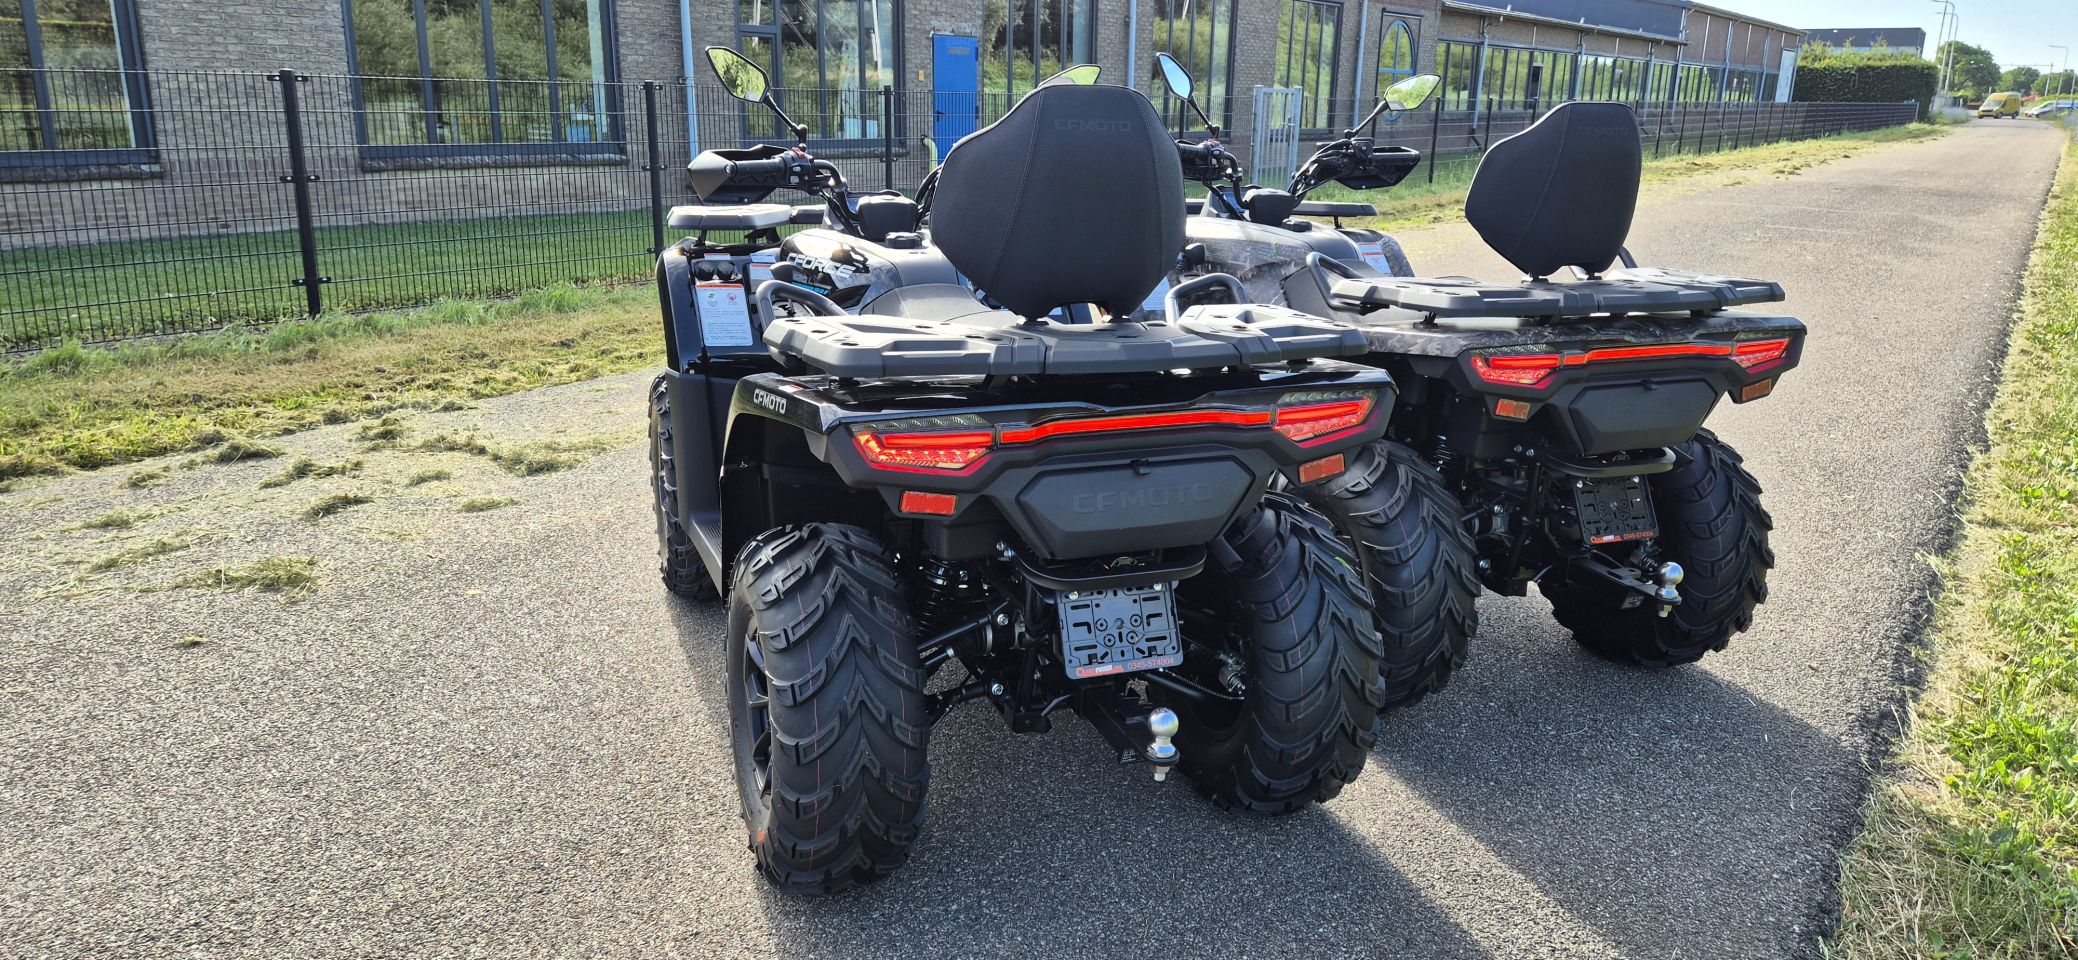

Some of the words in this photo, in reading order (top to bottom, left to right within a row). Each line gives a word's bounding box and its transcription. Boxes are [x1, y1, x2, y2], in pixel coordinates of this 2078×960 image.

[1054, 119, 1132, 132] CFMOTO
[786, 252, 857, 279] CFORCE
[753, 388, 787, 415] CFMOTO
[1075, 484, 1211, 514] CFMOTO
